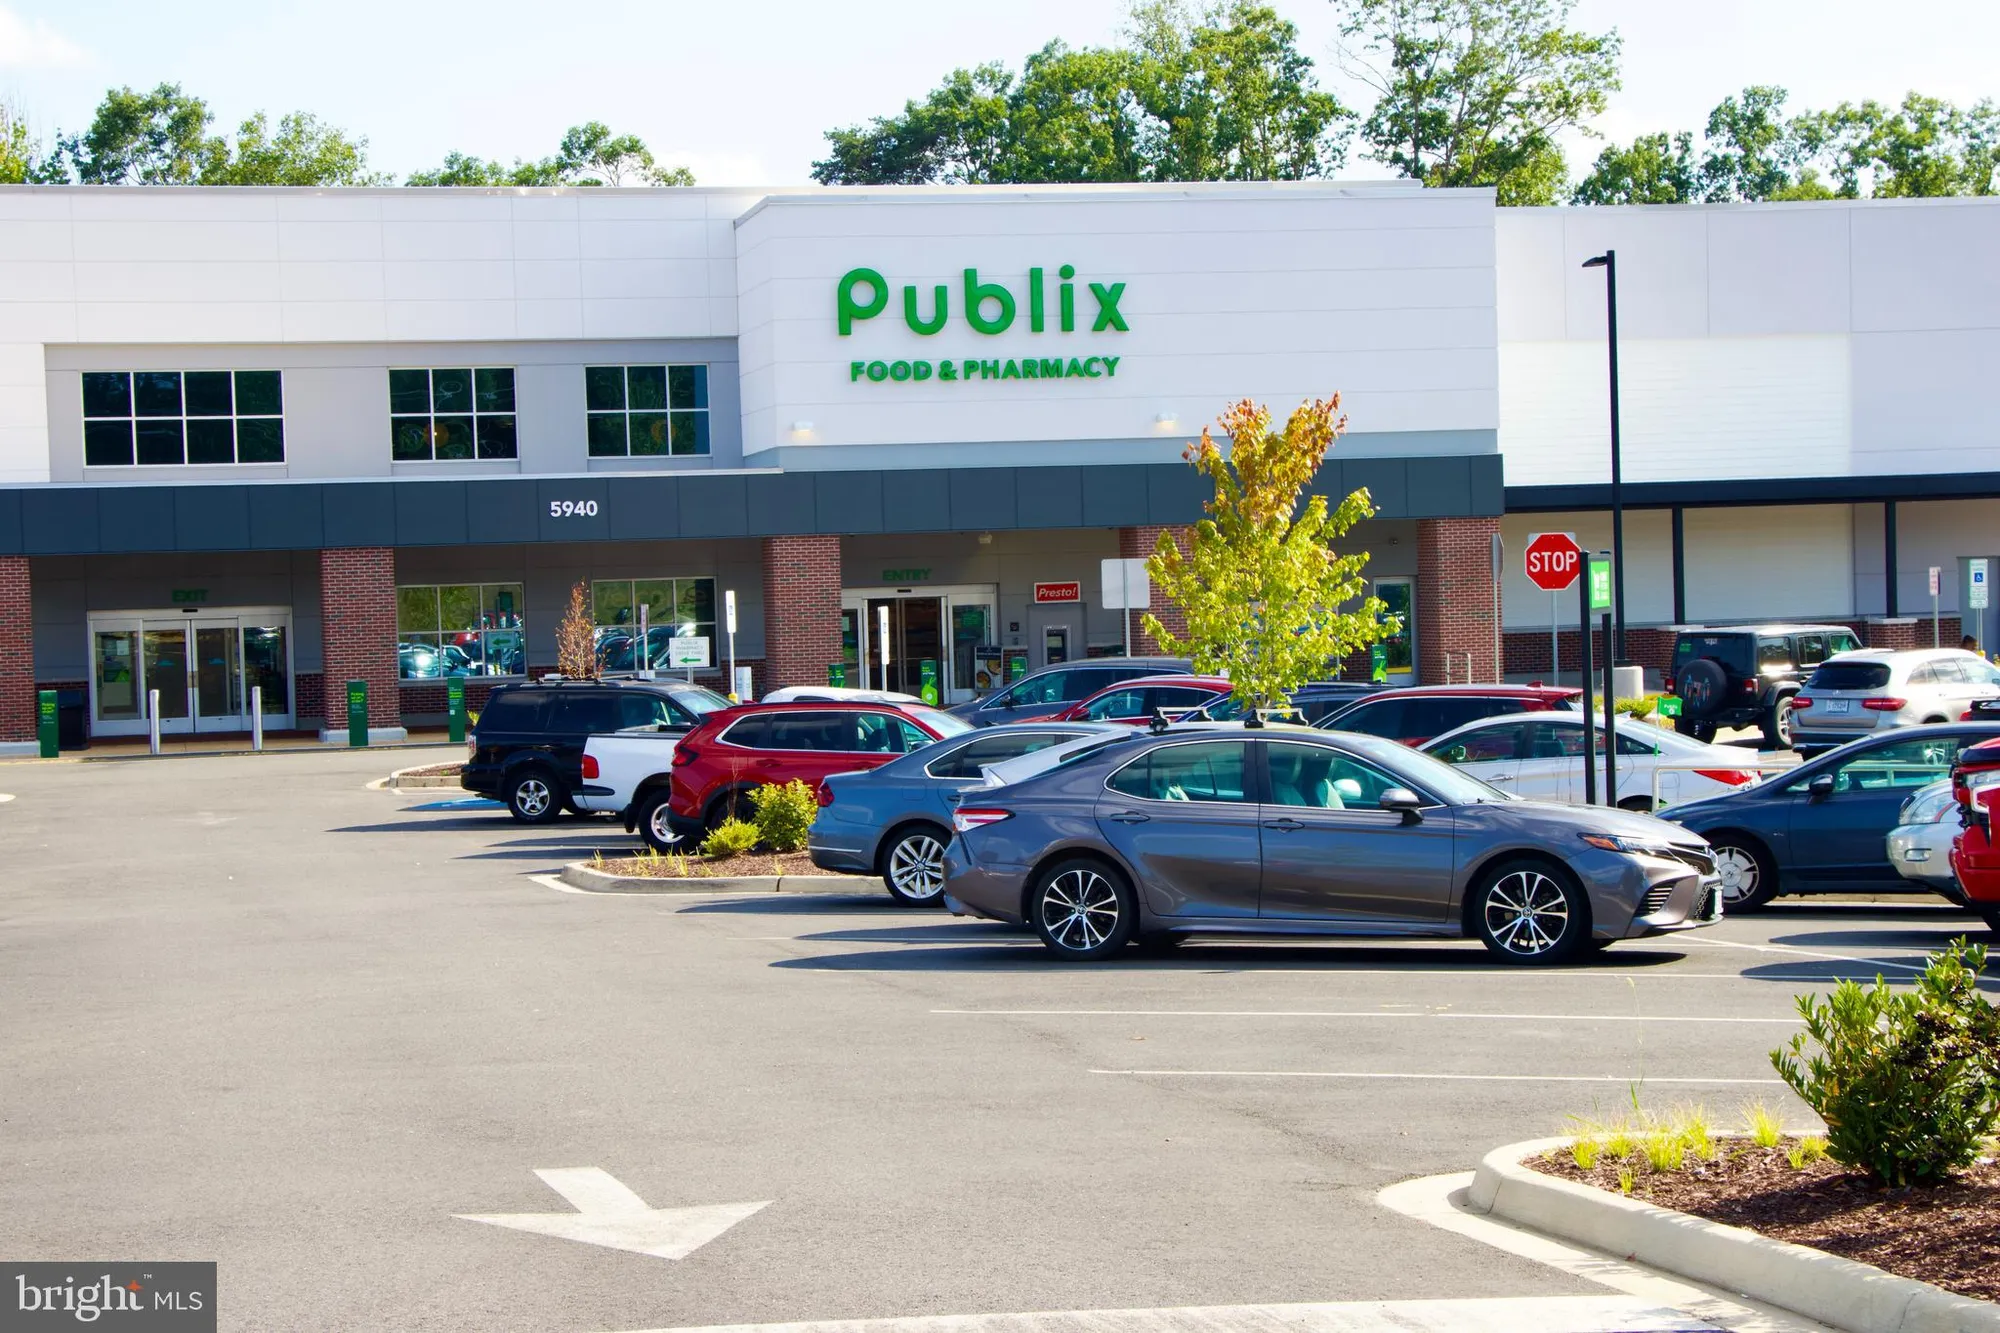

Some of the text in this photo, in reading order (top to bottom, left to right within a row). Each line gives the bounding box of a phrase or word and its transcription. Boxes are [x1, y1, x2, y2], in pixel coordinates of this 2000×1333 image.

[837, 264, 1130, 335] Publix
[851, 356, 1120, 382] FOOD & PHARMACY
[550, 500, 598, 517] 5940
[1529, 550, 1577, 572] STOP
[882, 568, 932, 581] ENTRY
[172, 589, 209, 602] EXIT
[1038, 586, 1077, 598] Presto!
